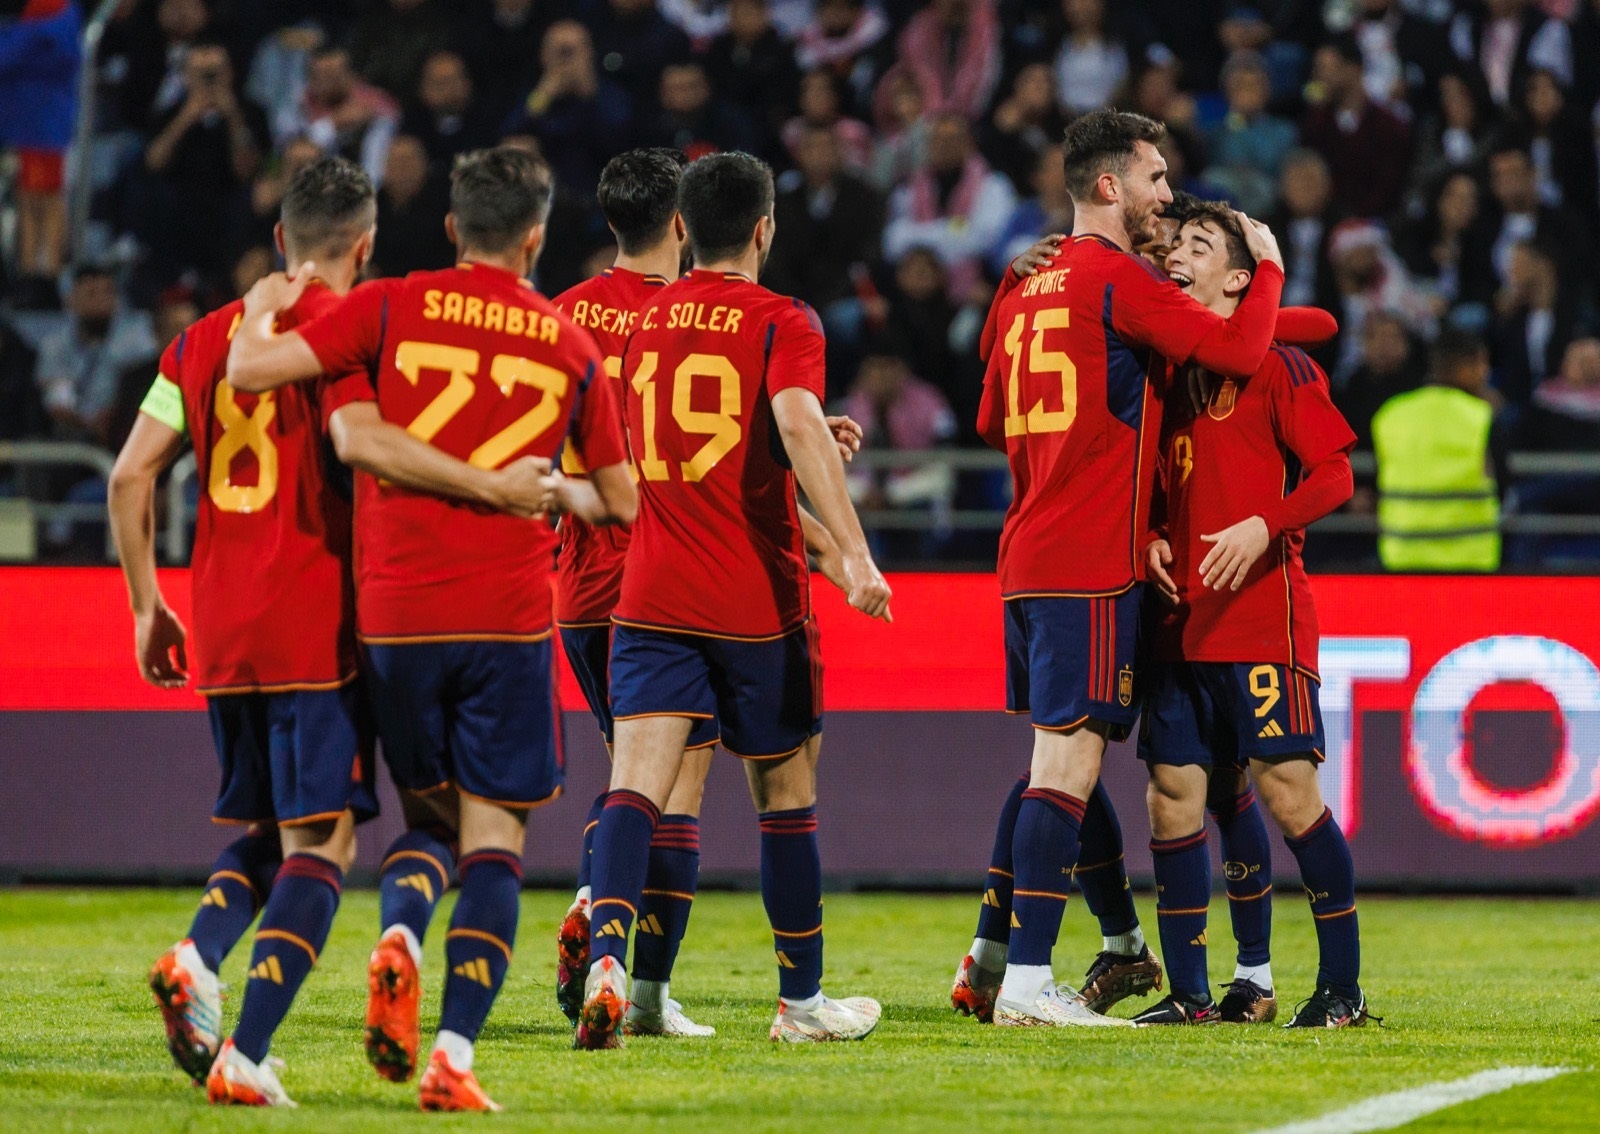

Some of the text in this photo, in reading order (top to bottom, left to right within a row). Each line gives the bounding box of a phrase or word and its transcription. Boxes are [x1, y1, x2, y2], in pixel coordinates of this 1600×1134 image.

[423, 289, 560, 345] SARABIA
[641, 301, 744, 334] C. SOLER
[1022, 268, 1071, 298] LAPORTE
[391, 340, 569, 474] 22
[631, 351, 742, 483] 19
[1003, 307, 1077, 437] 15
[207, 378, 278, 513] 8
[1174, 435, 1193, 484] 9
[1248, 664, 1281, 718] 9
[1318, 634, 1600, 847] TO
